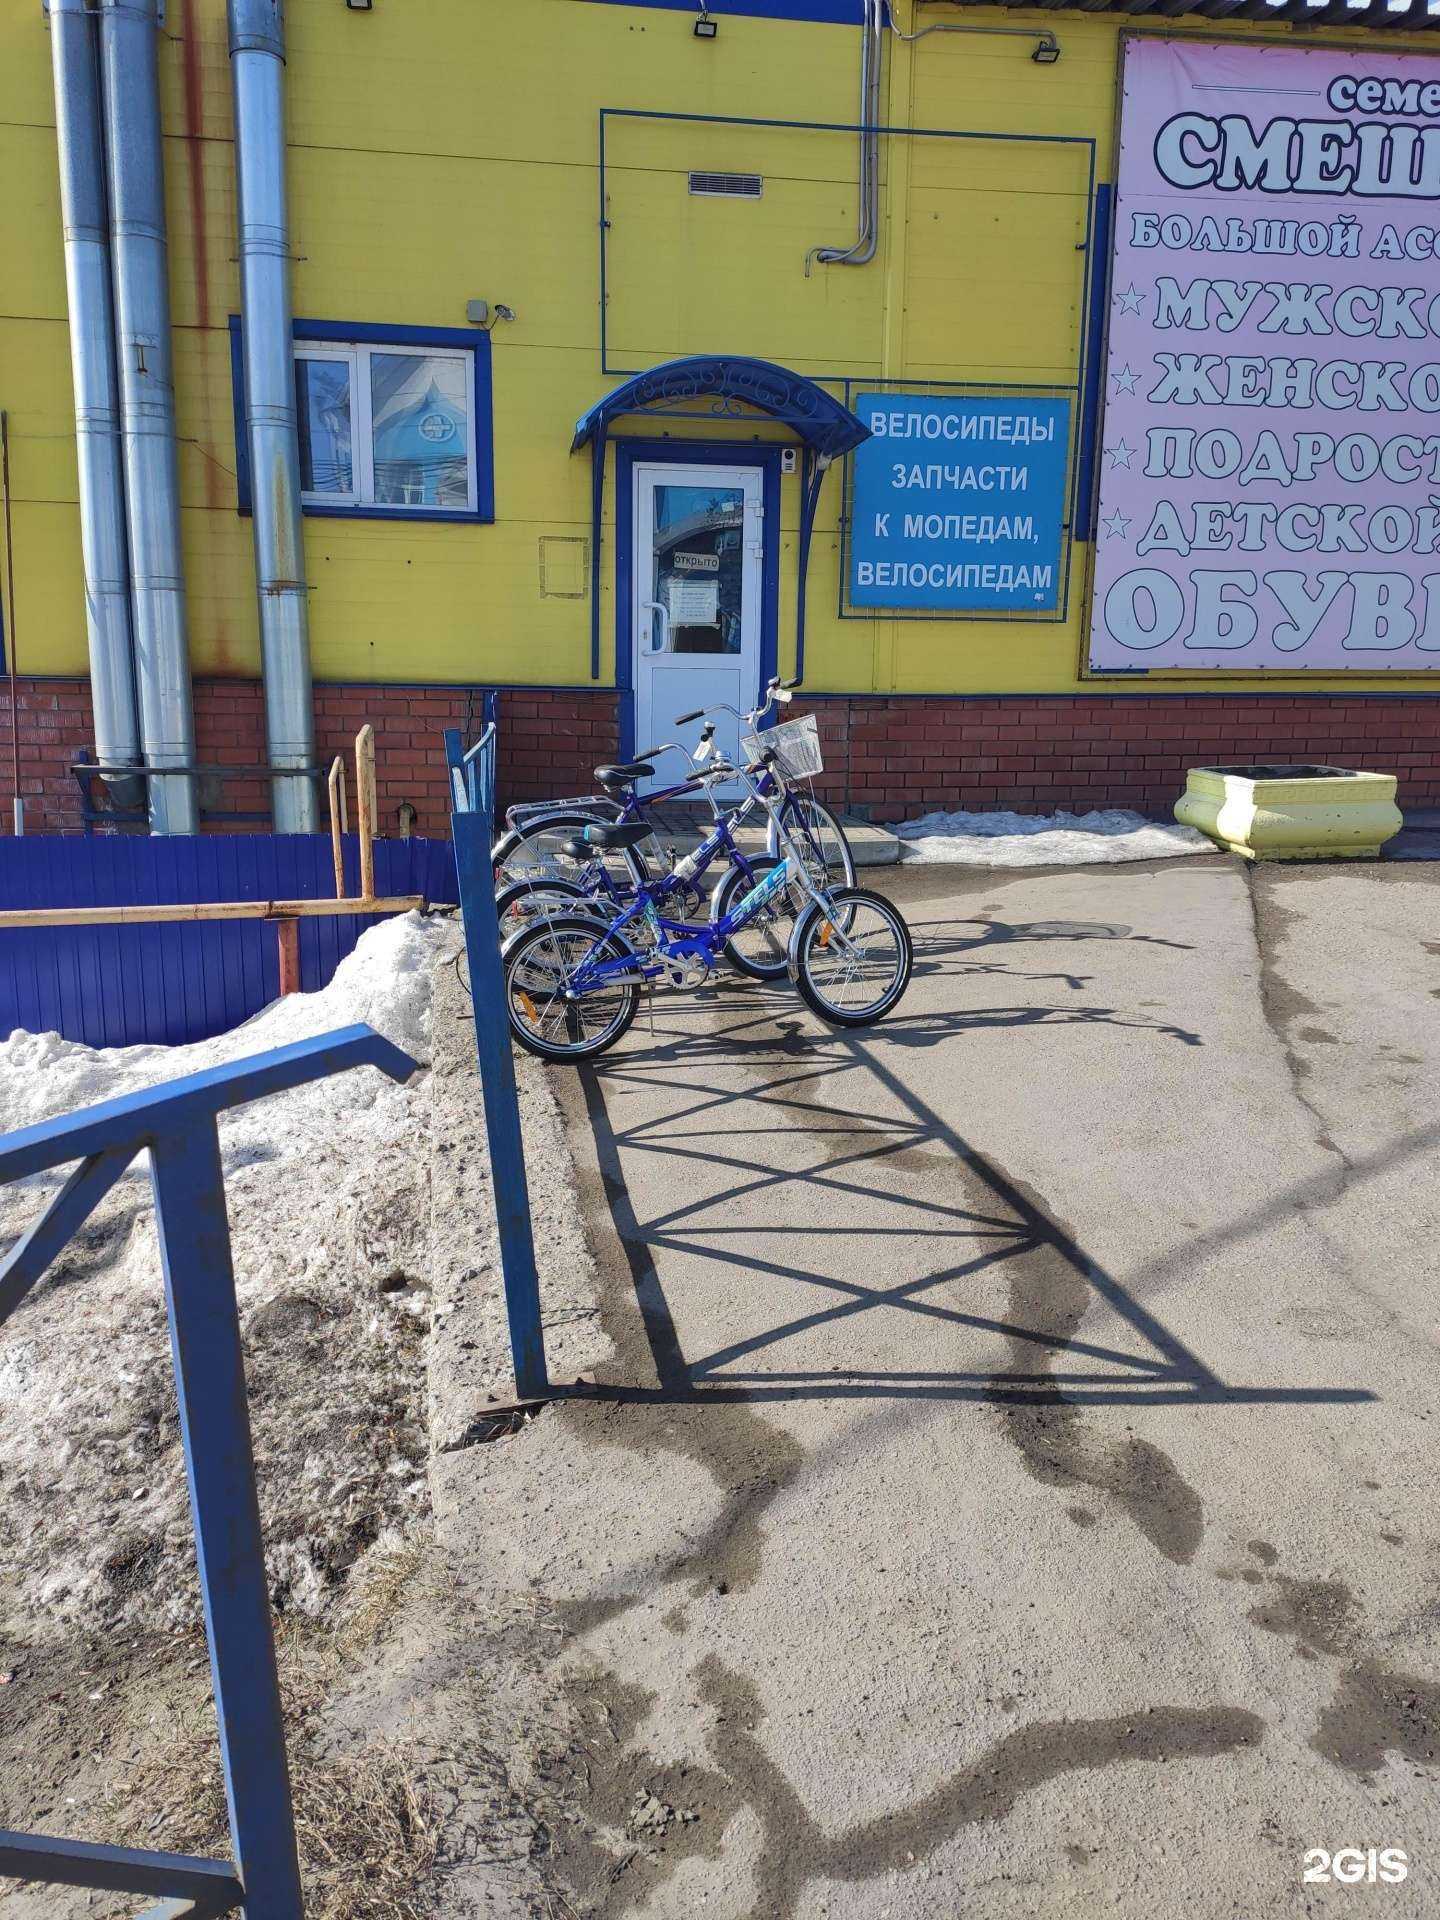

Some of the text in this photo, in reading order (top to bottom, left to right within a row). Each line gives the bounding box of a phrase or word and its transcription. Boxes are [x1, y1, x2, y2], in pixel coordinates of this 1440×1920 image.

[1153, 112, 1440, 200] СМЕШ
[1130, 213, 1440, 260] БОЛЬШОЙ АС
[1153, 277, 1440, 338] МУЖСК
[1147, 353, 1440, 413] ЖЕНСКО
[870, 412, 1055, 445] ВЕЛОСИПЕДЫ
[892, 463, 1028, 491] ЗАПЧАСТИ
[875, 513, 1039, 544] К МОПЕДАМ,
[857, 561, 1051, 592] ВЕЛОСИПЕДАМ
